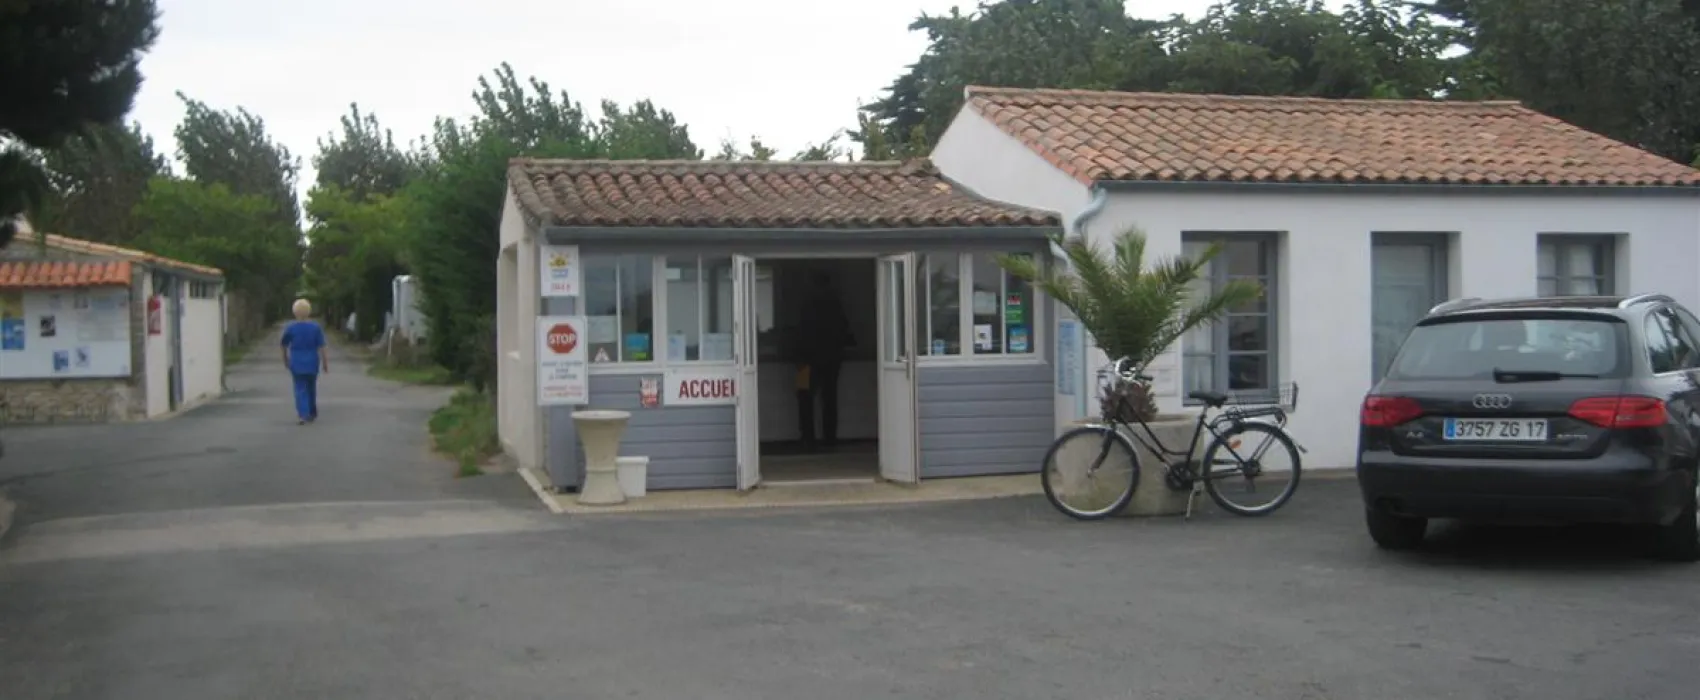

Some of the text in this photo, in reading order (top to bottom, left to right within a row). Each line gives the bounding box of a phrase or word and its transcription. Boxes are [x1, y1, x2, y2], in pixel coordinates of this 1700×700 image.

[548, 332, 577, 346] STOP
[679, 379, 736, 399] ACCUEI
[1455, 421, 1494, 437] 3757
[1499, 421, 1520, 437] ZG
[1526, 421, 1545, 437] 17
